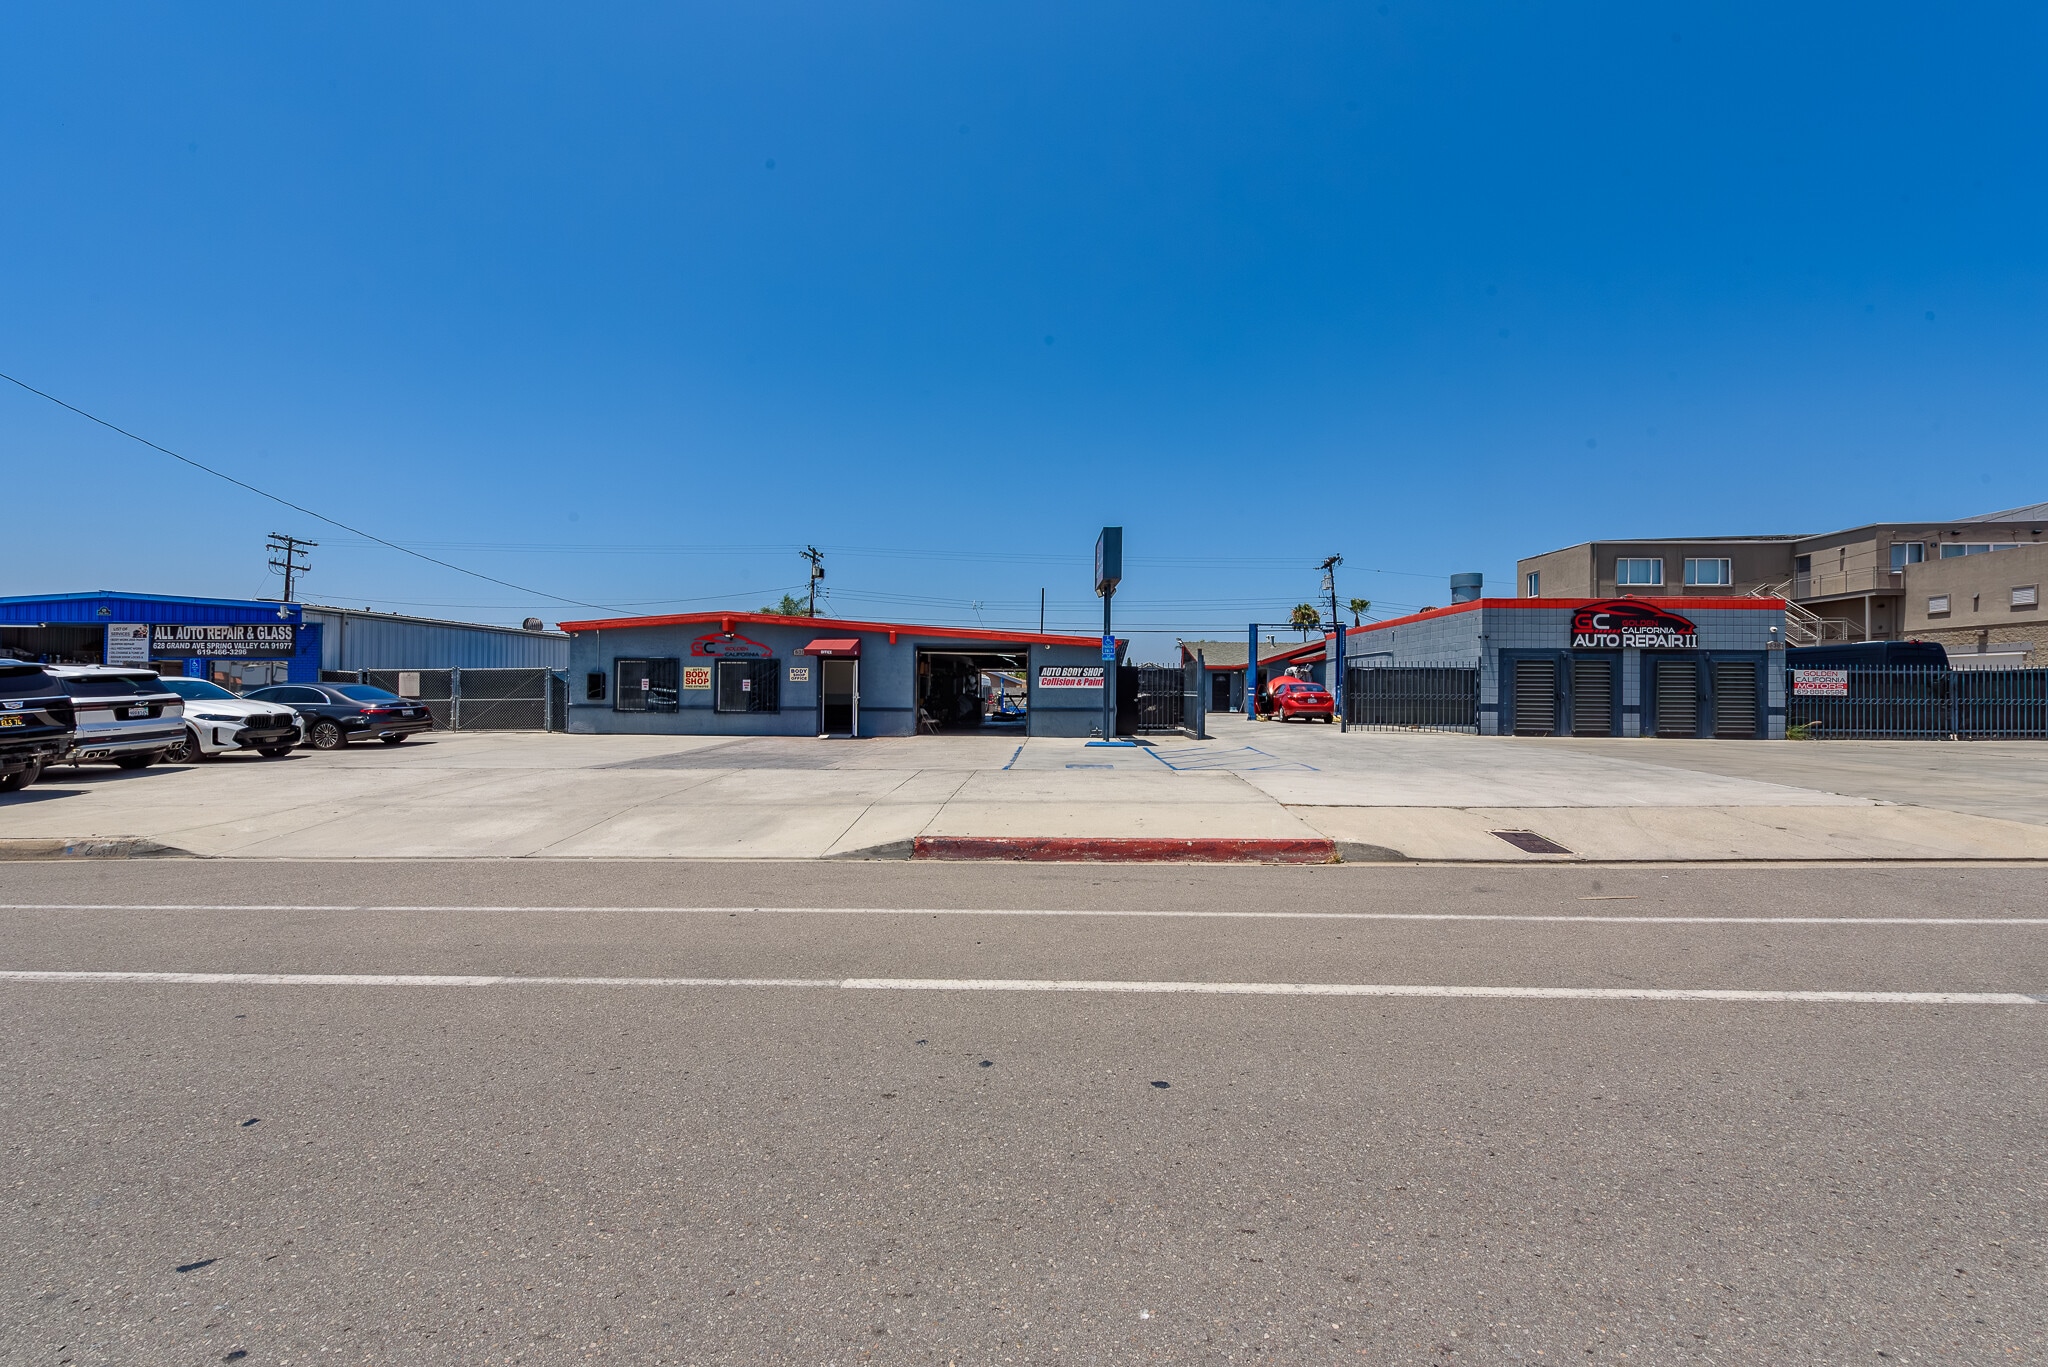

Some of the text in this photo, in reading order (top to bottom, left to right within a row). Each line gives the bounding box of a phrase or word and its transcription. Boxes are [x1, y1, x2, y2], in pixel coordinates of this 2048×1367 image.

[1575, 613, 1610, 629] GC
[154, 626, 292, 640] ALL AUTO REPAIR & GLASS
[1573, 634, 1619, 647] AUTO
[1623, 634, 1684, 647] REPAIR
[1041, 667, 1104, 676] AUTO BODY SHOP
[1041, 677, 1075, 686] Collision
[1083, 678, 1104, 686] Paint
